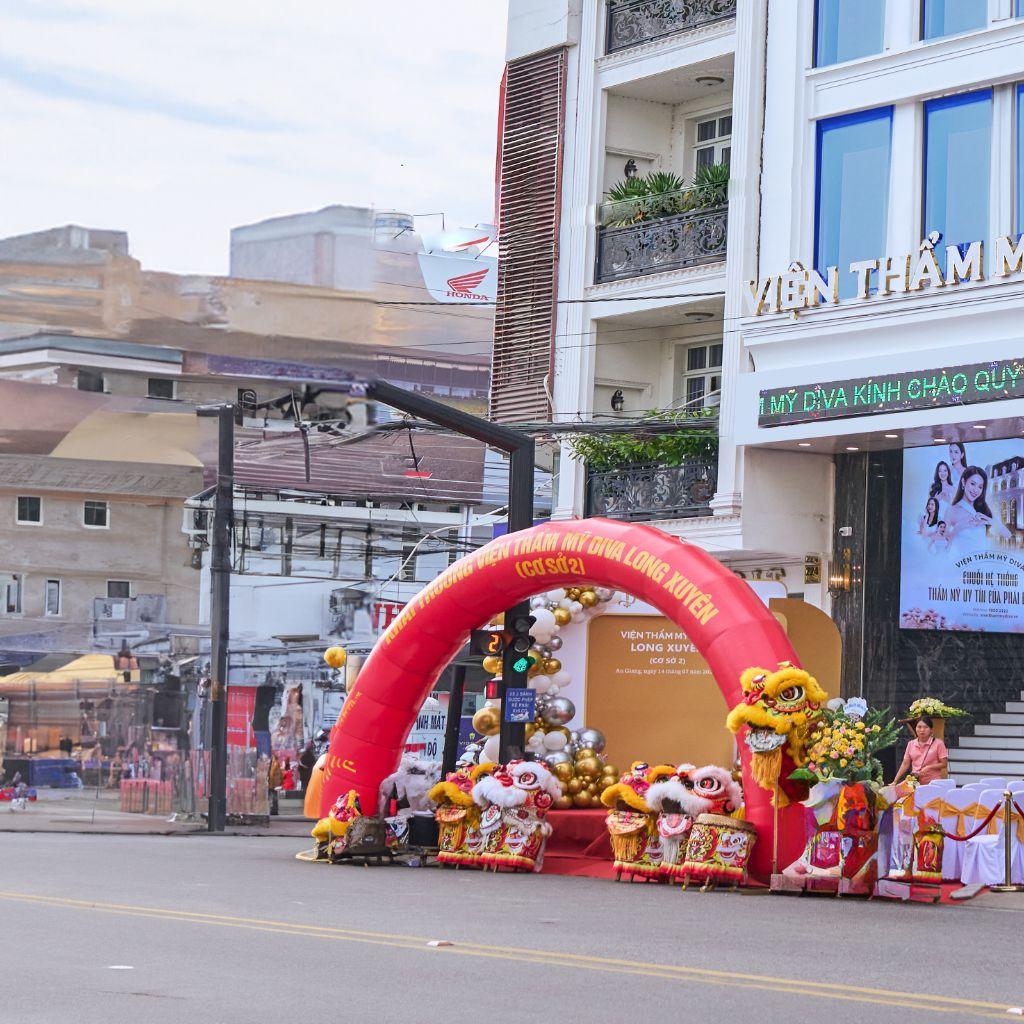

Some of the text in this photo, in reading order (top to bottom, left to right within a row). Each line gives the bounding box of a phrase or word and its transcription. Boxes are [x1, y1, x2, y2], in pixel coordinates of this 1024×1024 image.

[741, 261, 839, 320] VIỆN
[850, 230, 984, 300] THẨM
[446, 291, 489, 301] HONDA
[803, 387, 848, 412] DIVA
[853, 379, 901, 405] KÍNH
[545, 551, 569, 575] SỞ
[568, 557, 586, 576] 2)
[1008, 557, 1024, 572] DIVA
[587, 536, 626, 562] DIVA
[623, 546, 667, 584] LONG
[662, 569, 720, 625] XUYÊN
[963, 588, 973, 602] UY
[620, 629, 644, 640] VIỆN
[645, 628, 673, 640] THẨM
[630, 642, 699, 653] LONG XUYÊ
